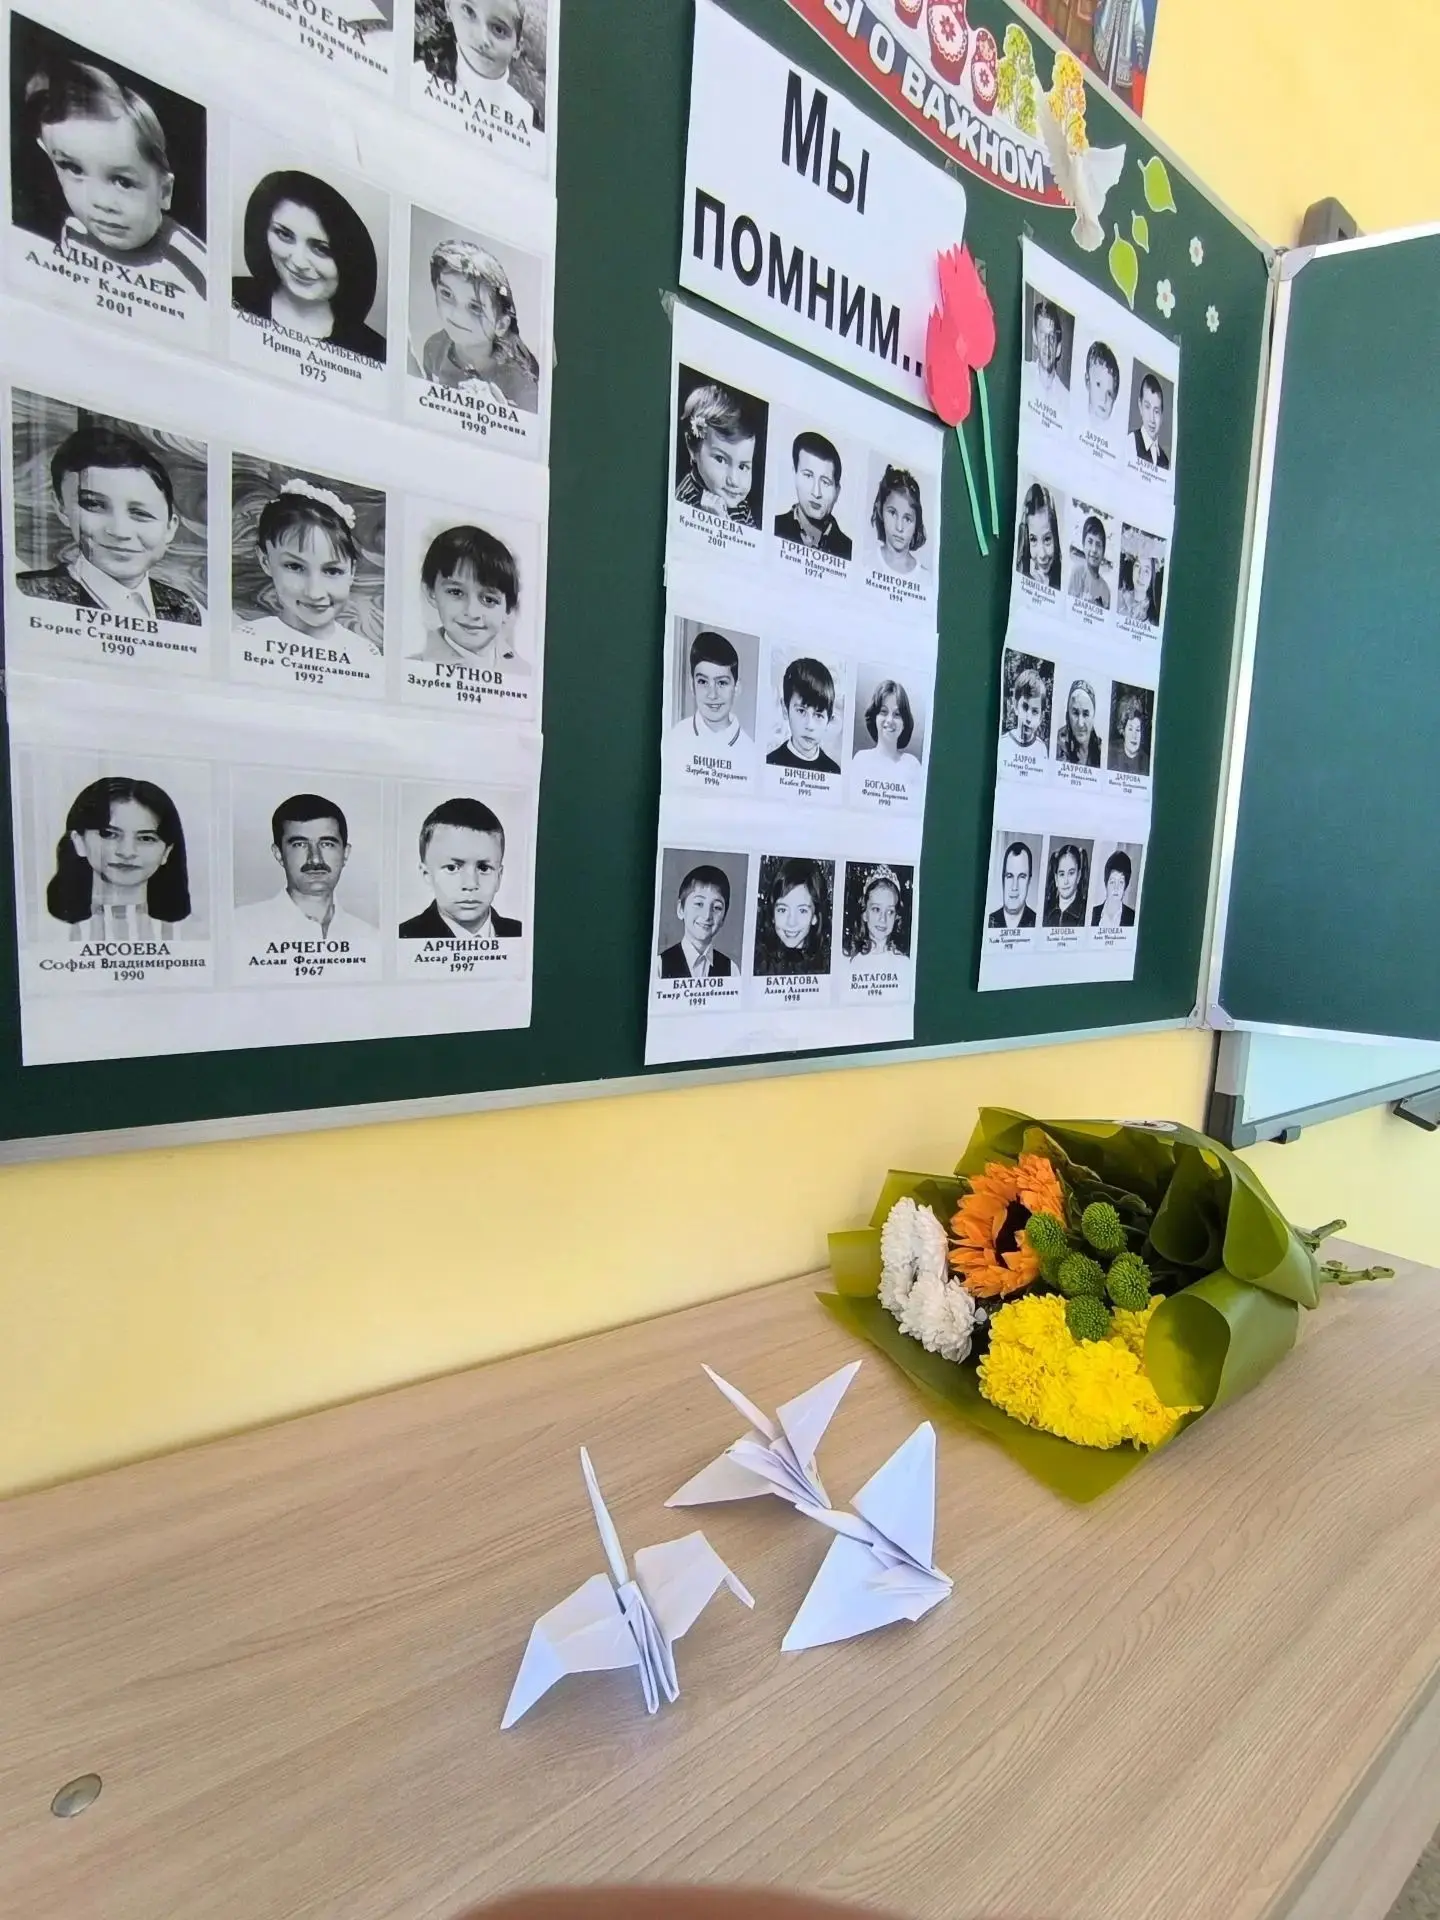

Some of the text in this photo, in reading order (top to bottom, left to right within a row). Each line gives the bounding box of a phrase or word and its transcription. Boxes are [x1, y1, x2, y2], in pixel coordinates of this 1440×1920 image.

[299, 15, 388, 75] Владимировна
[300, 32, 334, 61] 1992
[426, 73, 529, 135] ЛОЛАЕВА
[868, 22, 896, 75] О
[900, 56, 1045, 194] ВАЖНОМ
[464, 121, 495, 144] 1994
[781, 69, 870, 215] Мы
[52, 243, 177, 299] АДЫРХАЕВ
[25, 250, 186, 320] Альберт Казбекович
[96, 295, 133, 318] 2001
[262, 332, 362, 380] Ирина Аликовна
[299, 363, 328, 383] 1975
[426, 384, 519, 423] АЙЛЯРОВА
[419, 396, 527, 437] Светлана Юрьевна
[460, 420, 487, 436] 1998
[691, 508, 744, 536] ГОЛОЕВА
[707, 536, 726, 549] 2001
[780, 539, 846, 570] ГРИГОРЯН
[805, 567, 823, 579] 1974
[872, 570, 920, 592] ГРИГОРЯН
[75, 608, 159, 634] ГУРИЕВ
[29, 616, 198, 654] Борис Станиславович
[101, 641, 135, 657] 1990
[265, 639, 351, 665] ГУРИЕВА
[243, 651, 370, 680] Вера Станиславовна
[434, 663, 504, 685] ГУТНОВ
[294, 671, 324, 685] 1992
[407, 673, 529, 701] Заурбек Владимирович
[456, 691, 482, 704] 1994
[693, 754, 732, 770] БИЦИЕВ
[784, 768, 826, 782] БИЧЕНОВ
[864, 779, 906, 793] БОГАЗОВА
[80, 942, 171, 957] АРСОЕВА
[265, 940, 351, 954] АРЧЕГОВ
[423, 940, 500, 952] АРЧИНОВ
[39, 957, 207, 972] Софья Владимировна
[249, 955, 367, 966] Аслан Феликсович
[414, 952, 508, 963] Ахсар Борисович
[449, 962, 475, 973] 1997
[113, 970, 145, 981] 1990
[294, 966, 324, 976] 1967
[766, 976, 819, 986] БАТАГОВА
[851, 972, 898, 982] БАТАГОВА
[673, 978, 724, 990] БАТАГОВ
